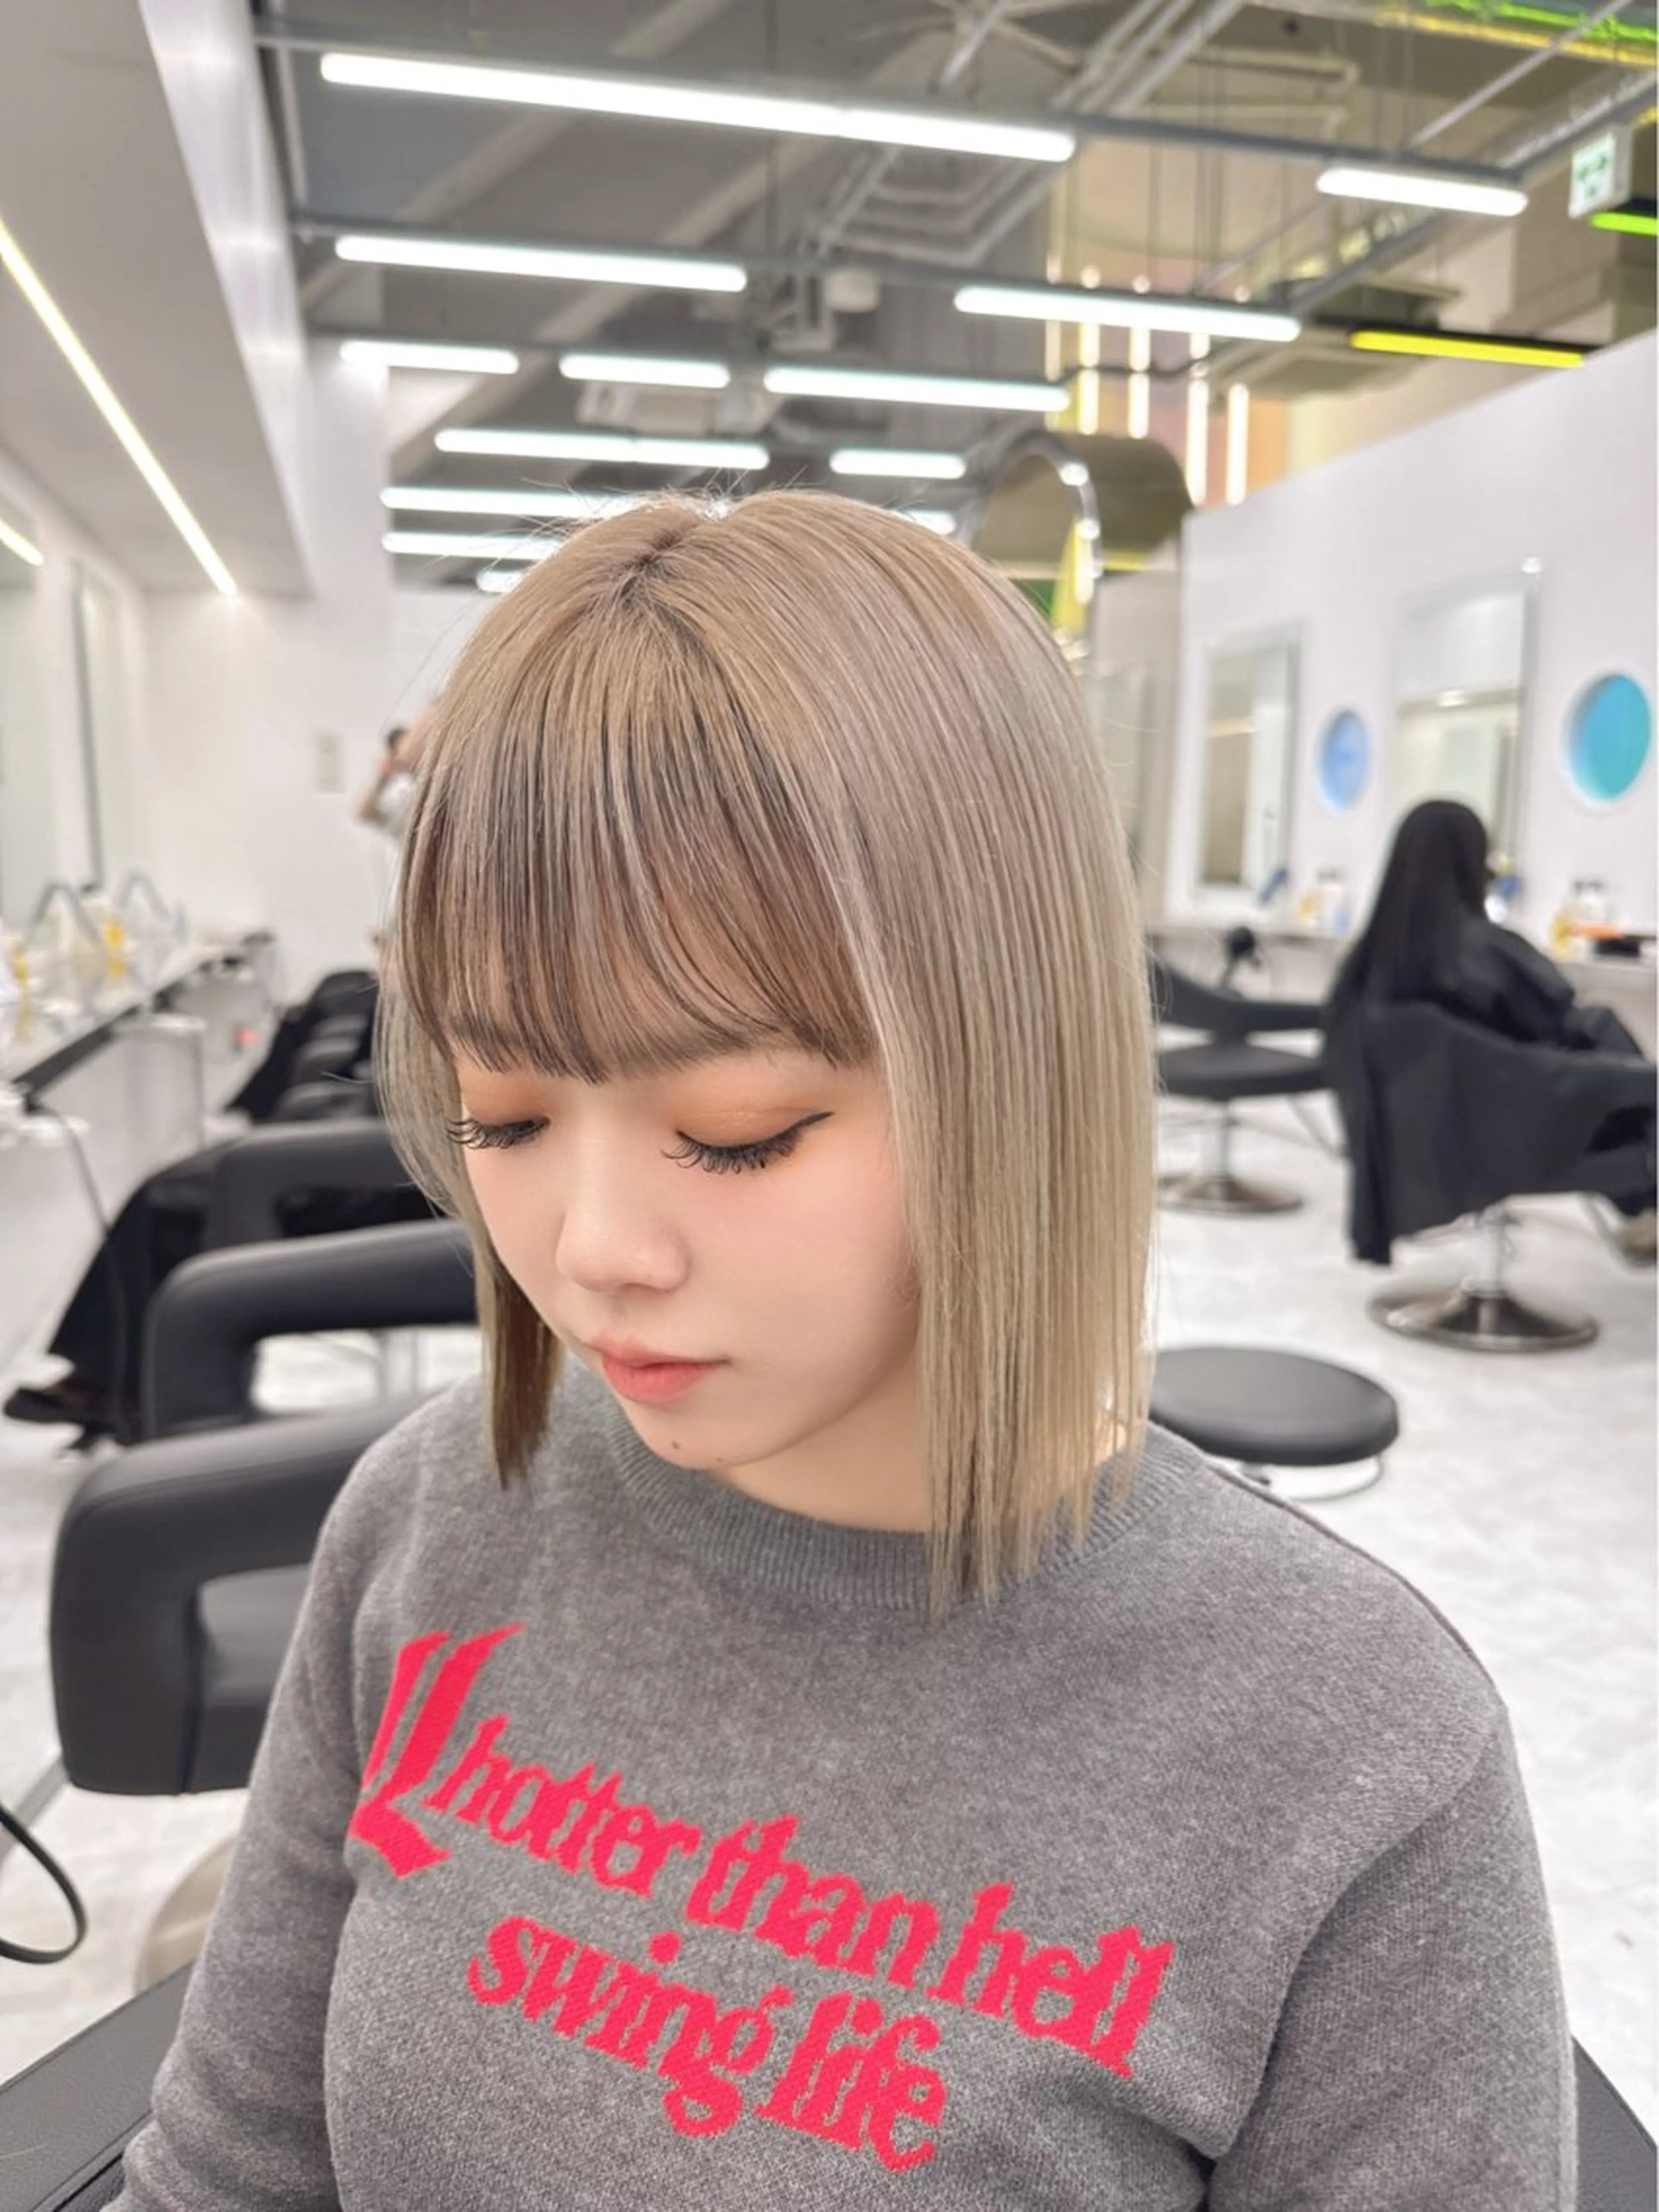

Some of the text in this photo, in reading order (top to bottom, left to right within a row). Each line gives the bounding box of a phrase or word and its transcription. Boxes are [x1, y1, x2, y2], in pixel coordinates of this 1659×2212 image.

[421, 1713, 703, 1898] hotter
[684, 1814, 940, 1990] than
[925, 1882, 1174, 2079] hell
[467, 1916, 947, 2173] swing life
